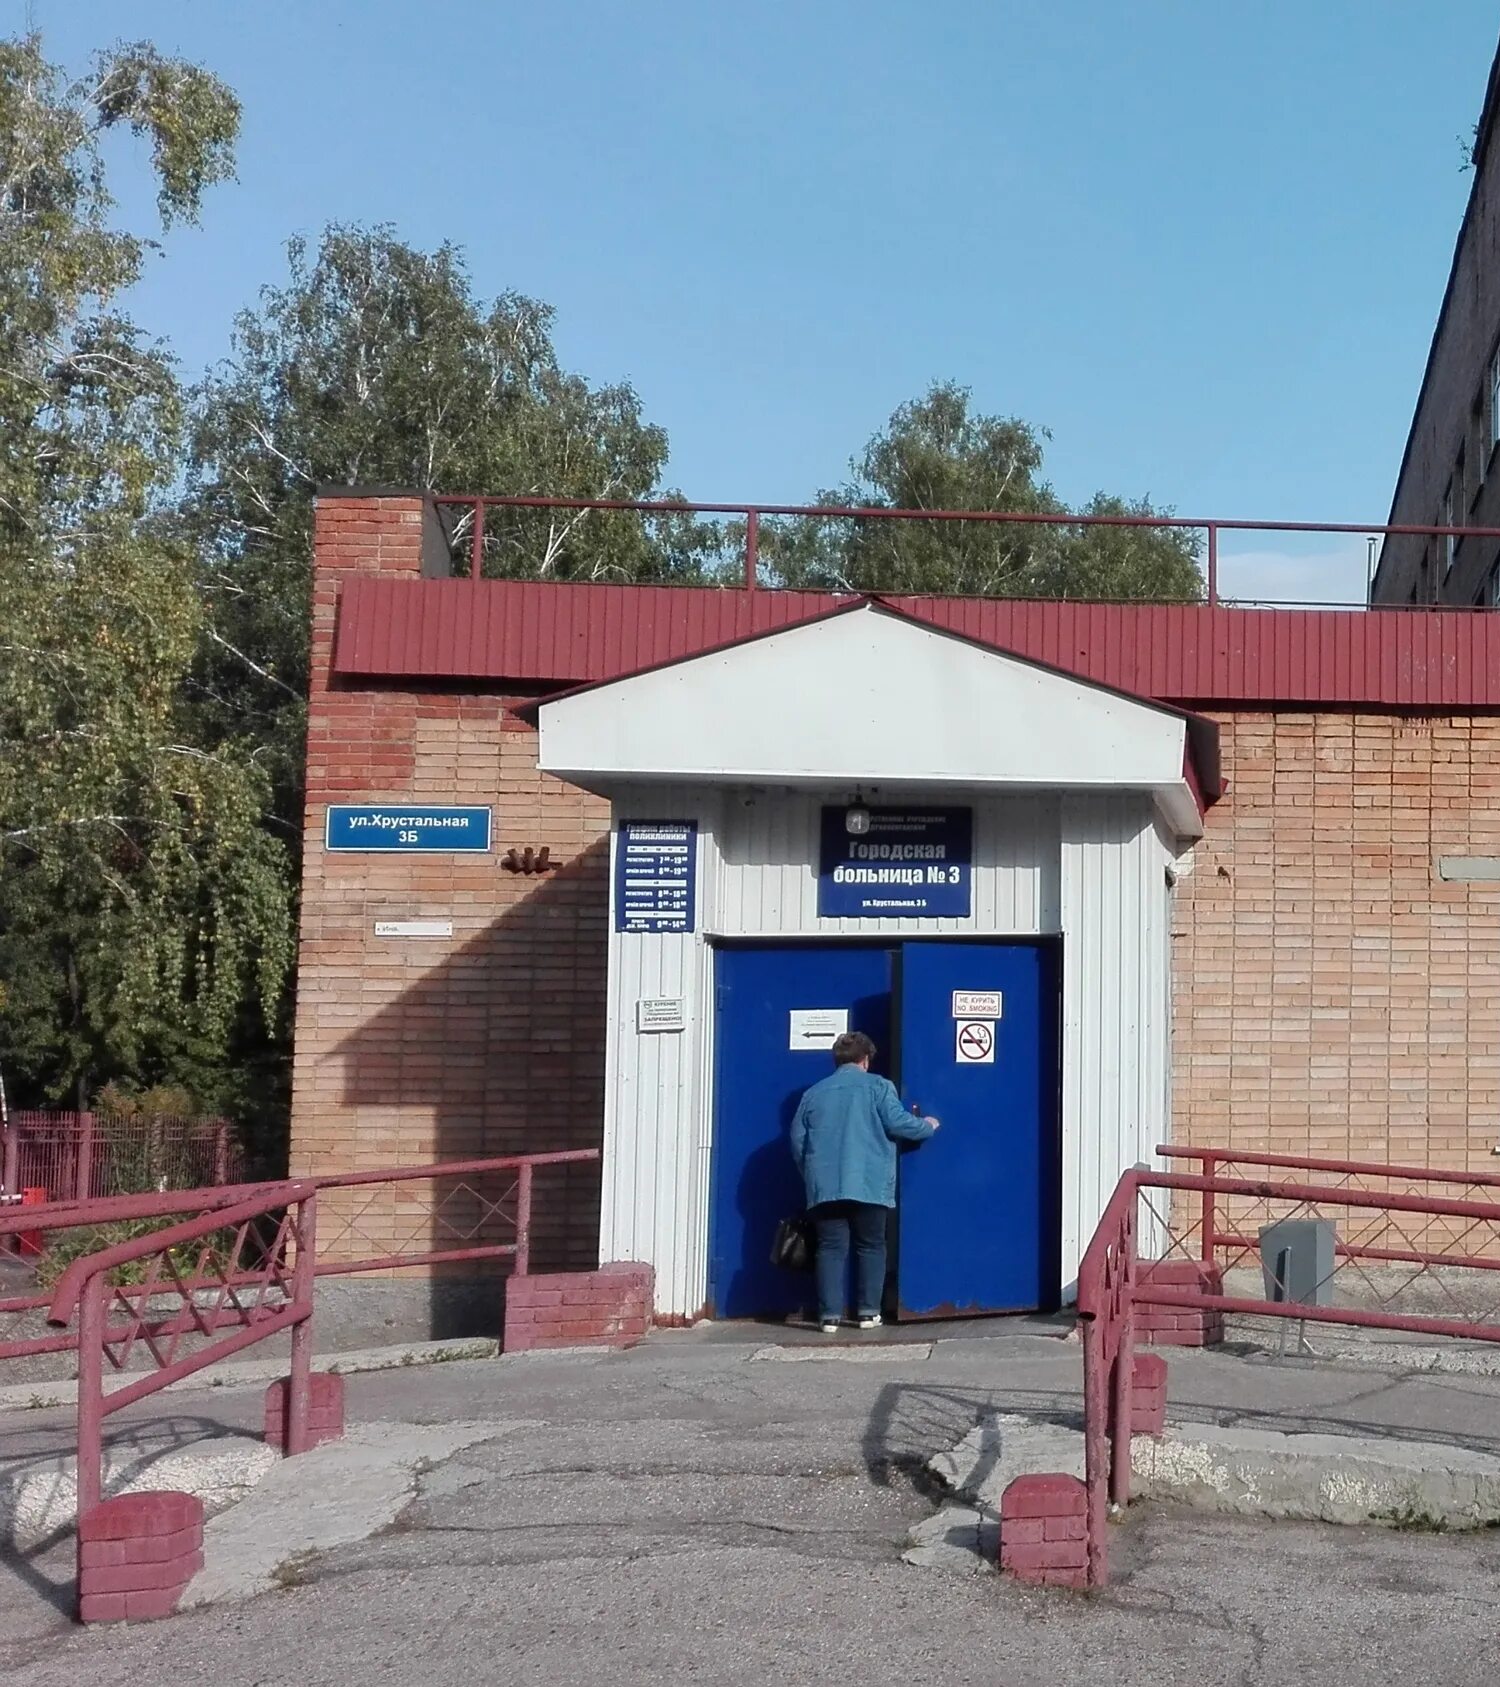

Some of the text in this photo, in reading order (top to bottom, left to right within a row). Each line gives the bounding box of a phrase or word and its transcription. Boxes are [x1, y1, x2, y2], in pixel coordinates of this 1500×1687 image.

[349, 814, 469, 829] ул.Хрустальная
[398, 830, 418, 842] 3Б
[848, 841, 946, 861] Городская
[833, 865, 923, 886] больница
[948, 866, 960, 884] 3
[970, 996, 995, 1004] КУРИТЬ
